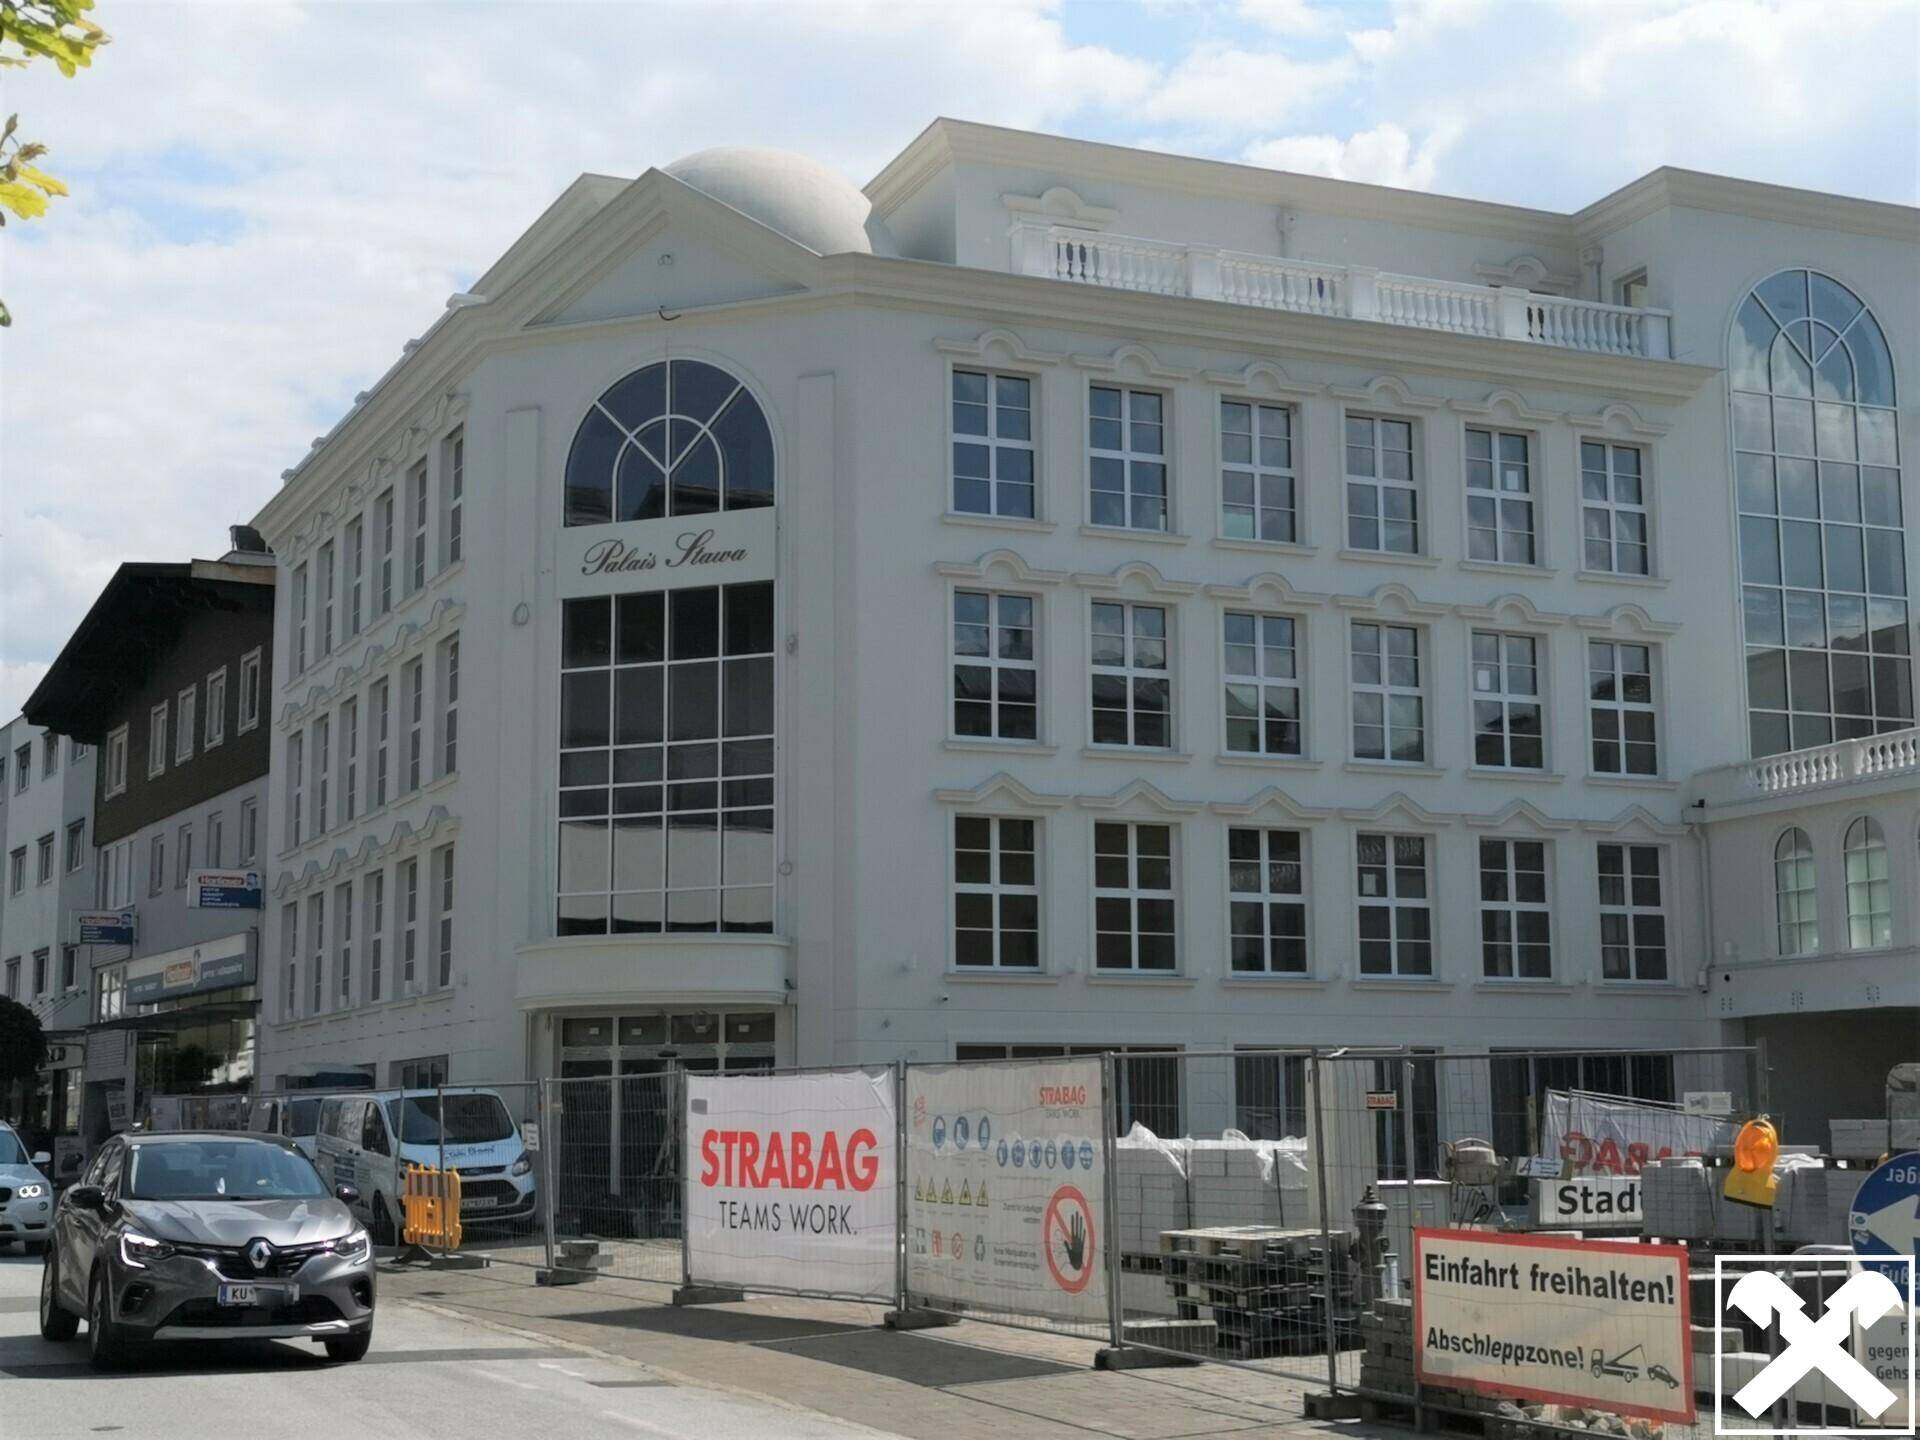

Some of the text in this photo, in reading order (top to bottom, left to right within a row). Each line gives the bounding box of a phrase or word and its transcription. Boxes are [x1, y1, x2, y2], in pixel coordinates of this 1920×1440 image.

[581, 528, 748, 576] Palais Stawa
[1039, 1085, 1086, 1106] STRABAG
[701, 1128, 879, 1192] STRABAG
[1885, 1165, 1920, 1184] ger
[719, 1201, 858, 1235] TEAMS WORK.
[1558, 1183, 1643, 1215] Stad
[1425, 1253, 1675, 1305] Einfahrt freihalten!
[1426, 1327, 1584, 1370] Abschleppzone!
